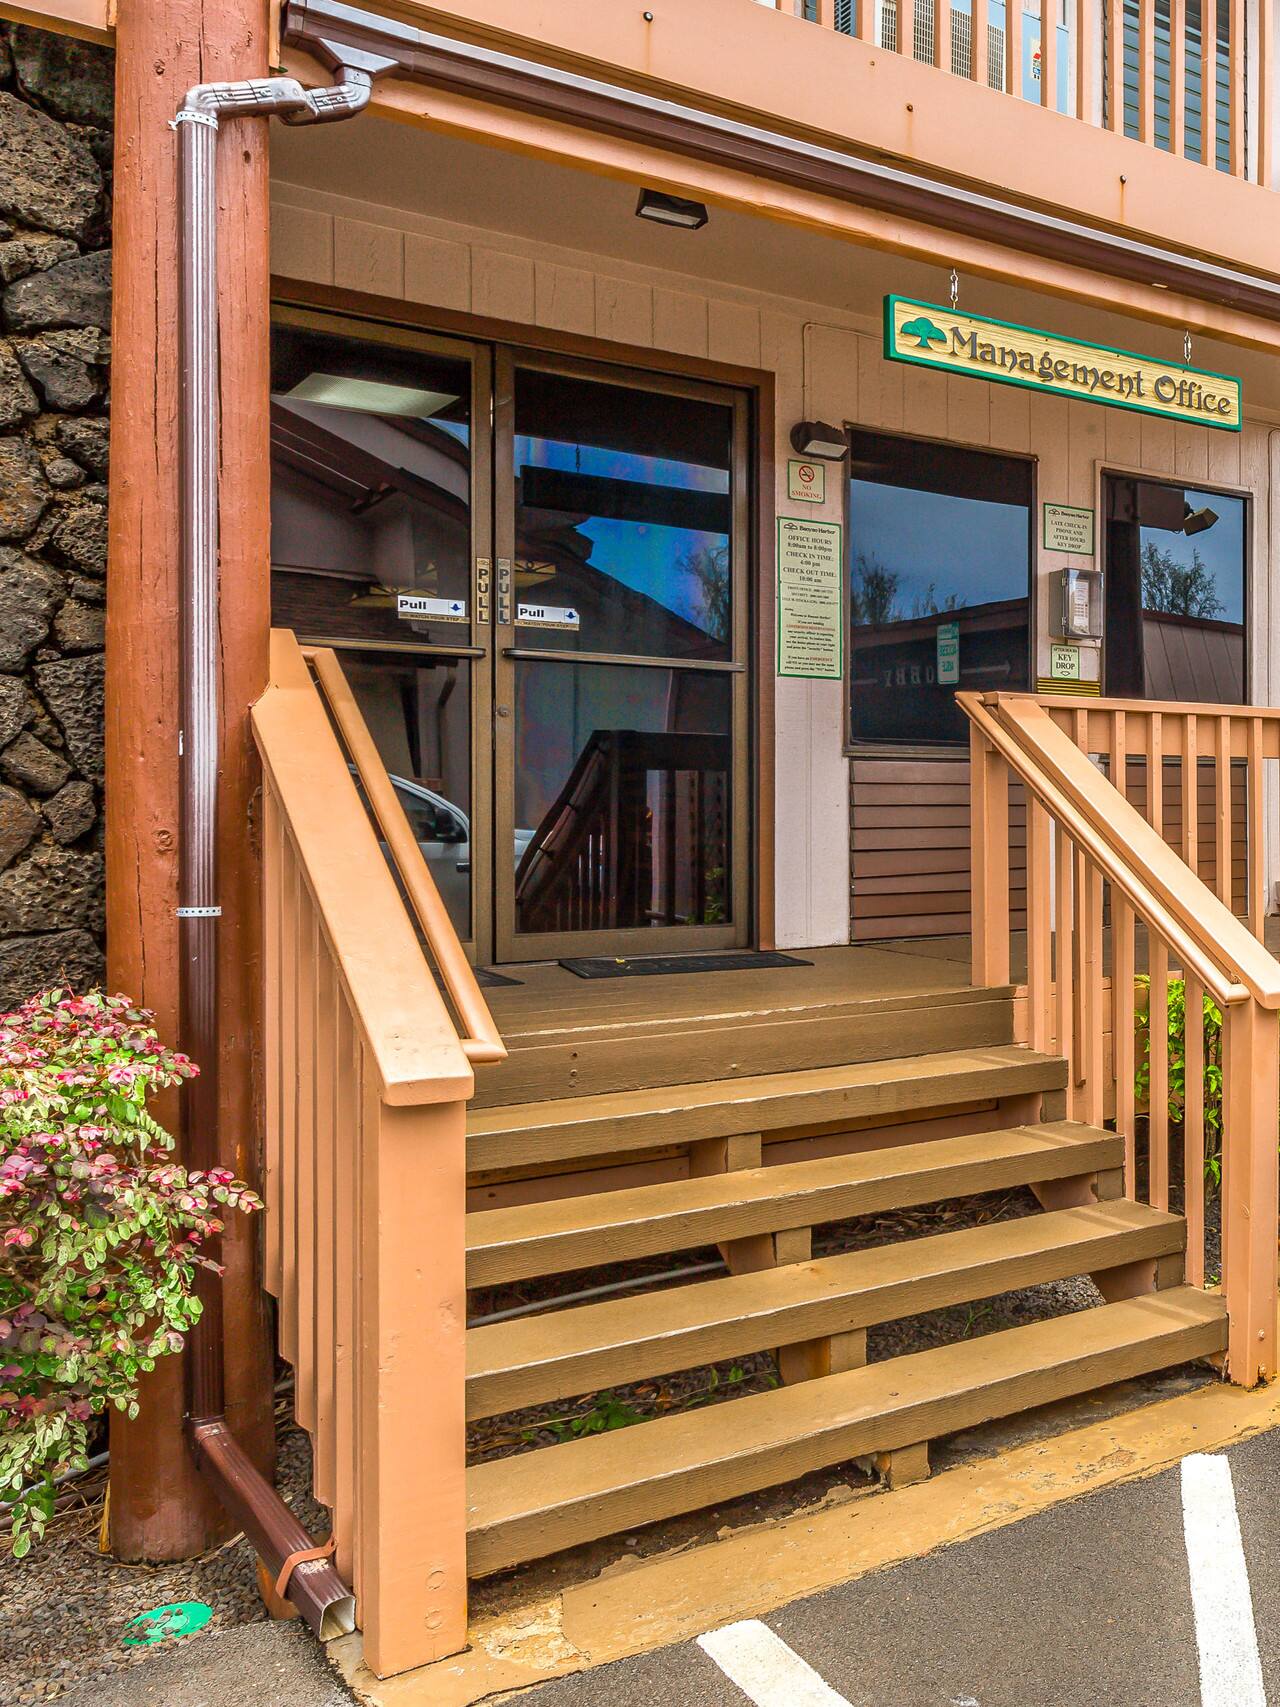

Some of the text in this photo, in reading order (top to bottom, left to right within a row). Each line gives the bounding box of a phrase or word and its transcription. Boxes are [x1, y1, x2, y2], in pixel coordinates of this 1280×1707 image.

[950, 327, 1231, 416] Management Office
[792, 491, 822, 499] SMOKING
[478, 569, 488, 622] PULL
[499, 569, 509, 622] PULL
[400, 600, 427, 609] Pull
[520, 608, 544, 617] Pull
[1056, 662, 1075, 670] DROP
